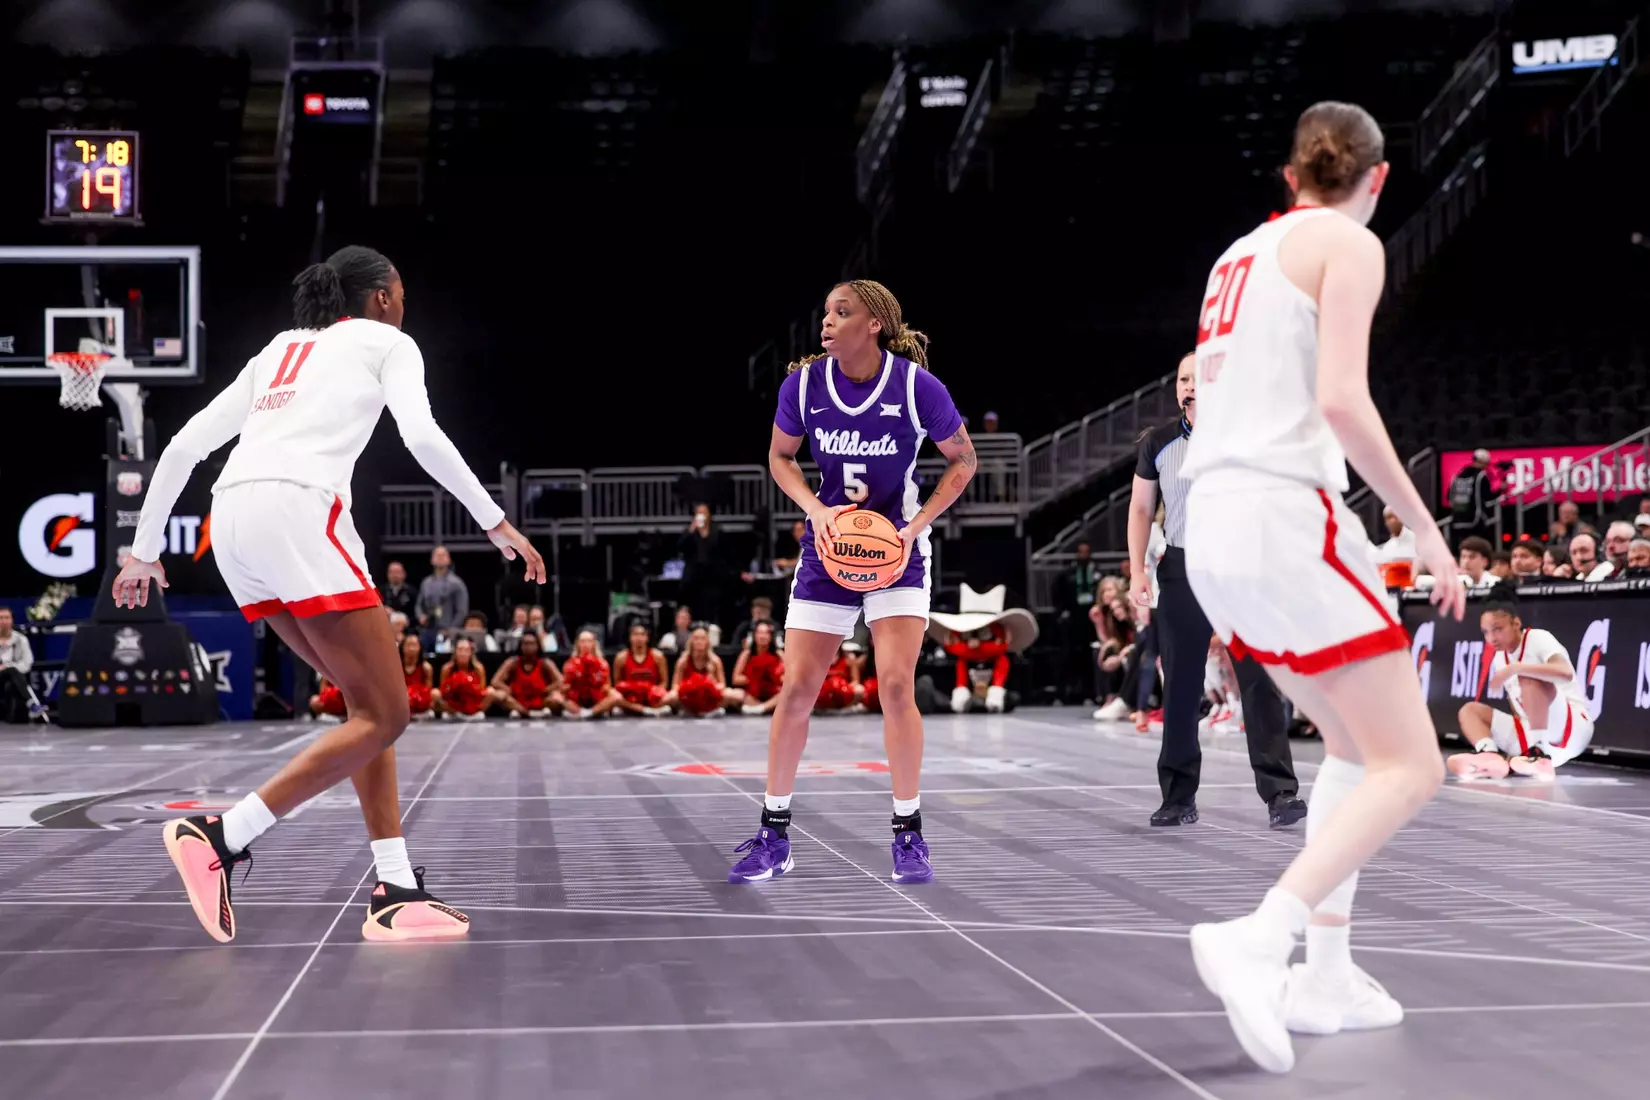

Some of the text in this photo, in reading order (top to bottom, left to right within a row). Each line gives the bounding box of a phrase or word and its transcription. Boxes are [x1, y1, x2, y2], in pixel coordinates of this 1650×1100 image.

[1512, 34, 1617, 67] UMB
[75, 140, 129, 166] 7:18
[82, 167, 121, 210] 19
[1197, 254, 1255, 345] 20
[268, 341, 316, 389] 11
[814, 427, 899, 456] Wildcats
[842, 462, 869, 502] 5
[18, 492, 96, 578] G
[833, 541, 886, 560] Wilson
[837, 568, 878, 582] NCAA
